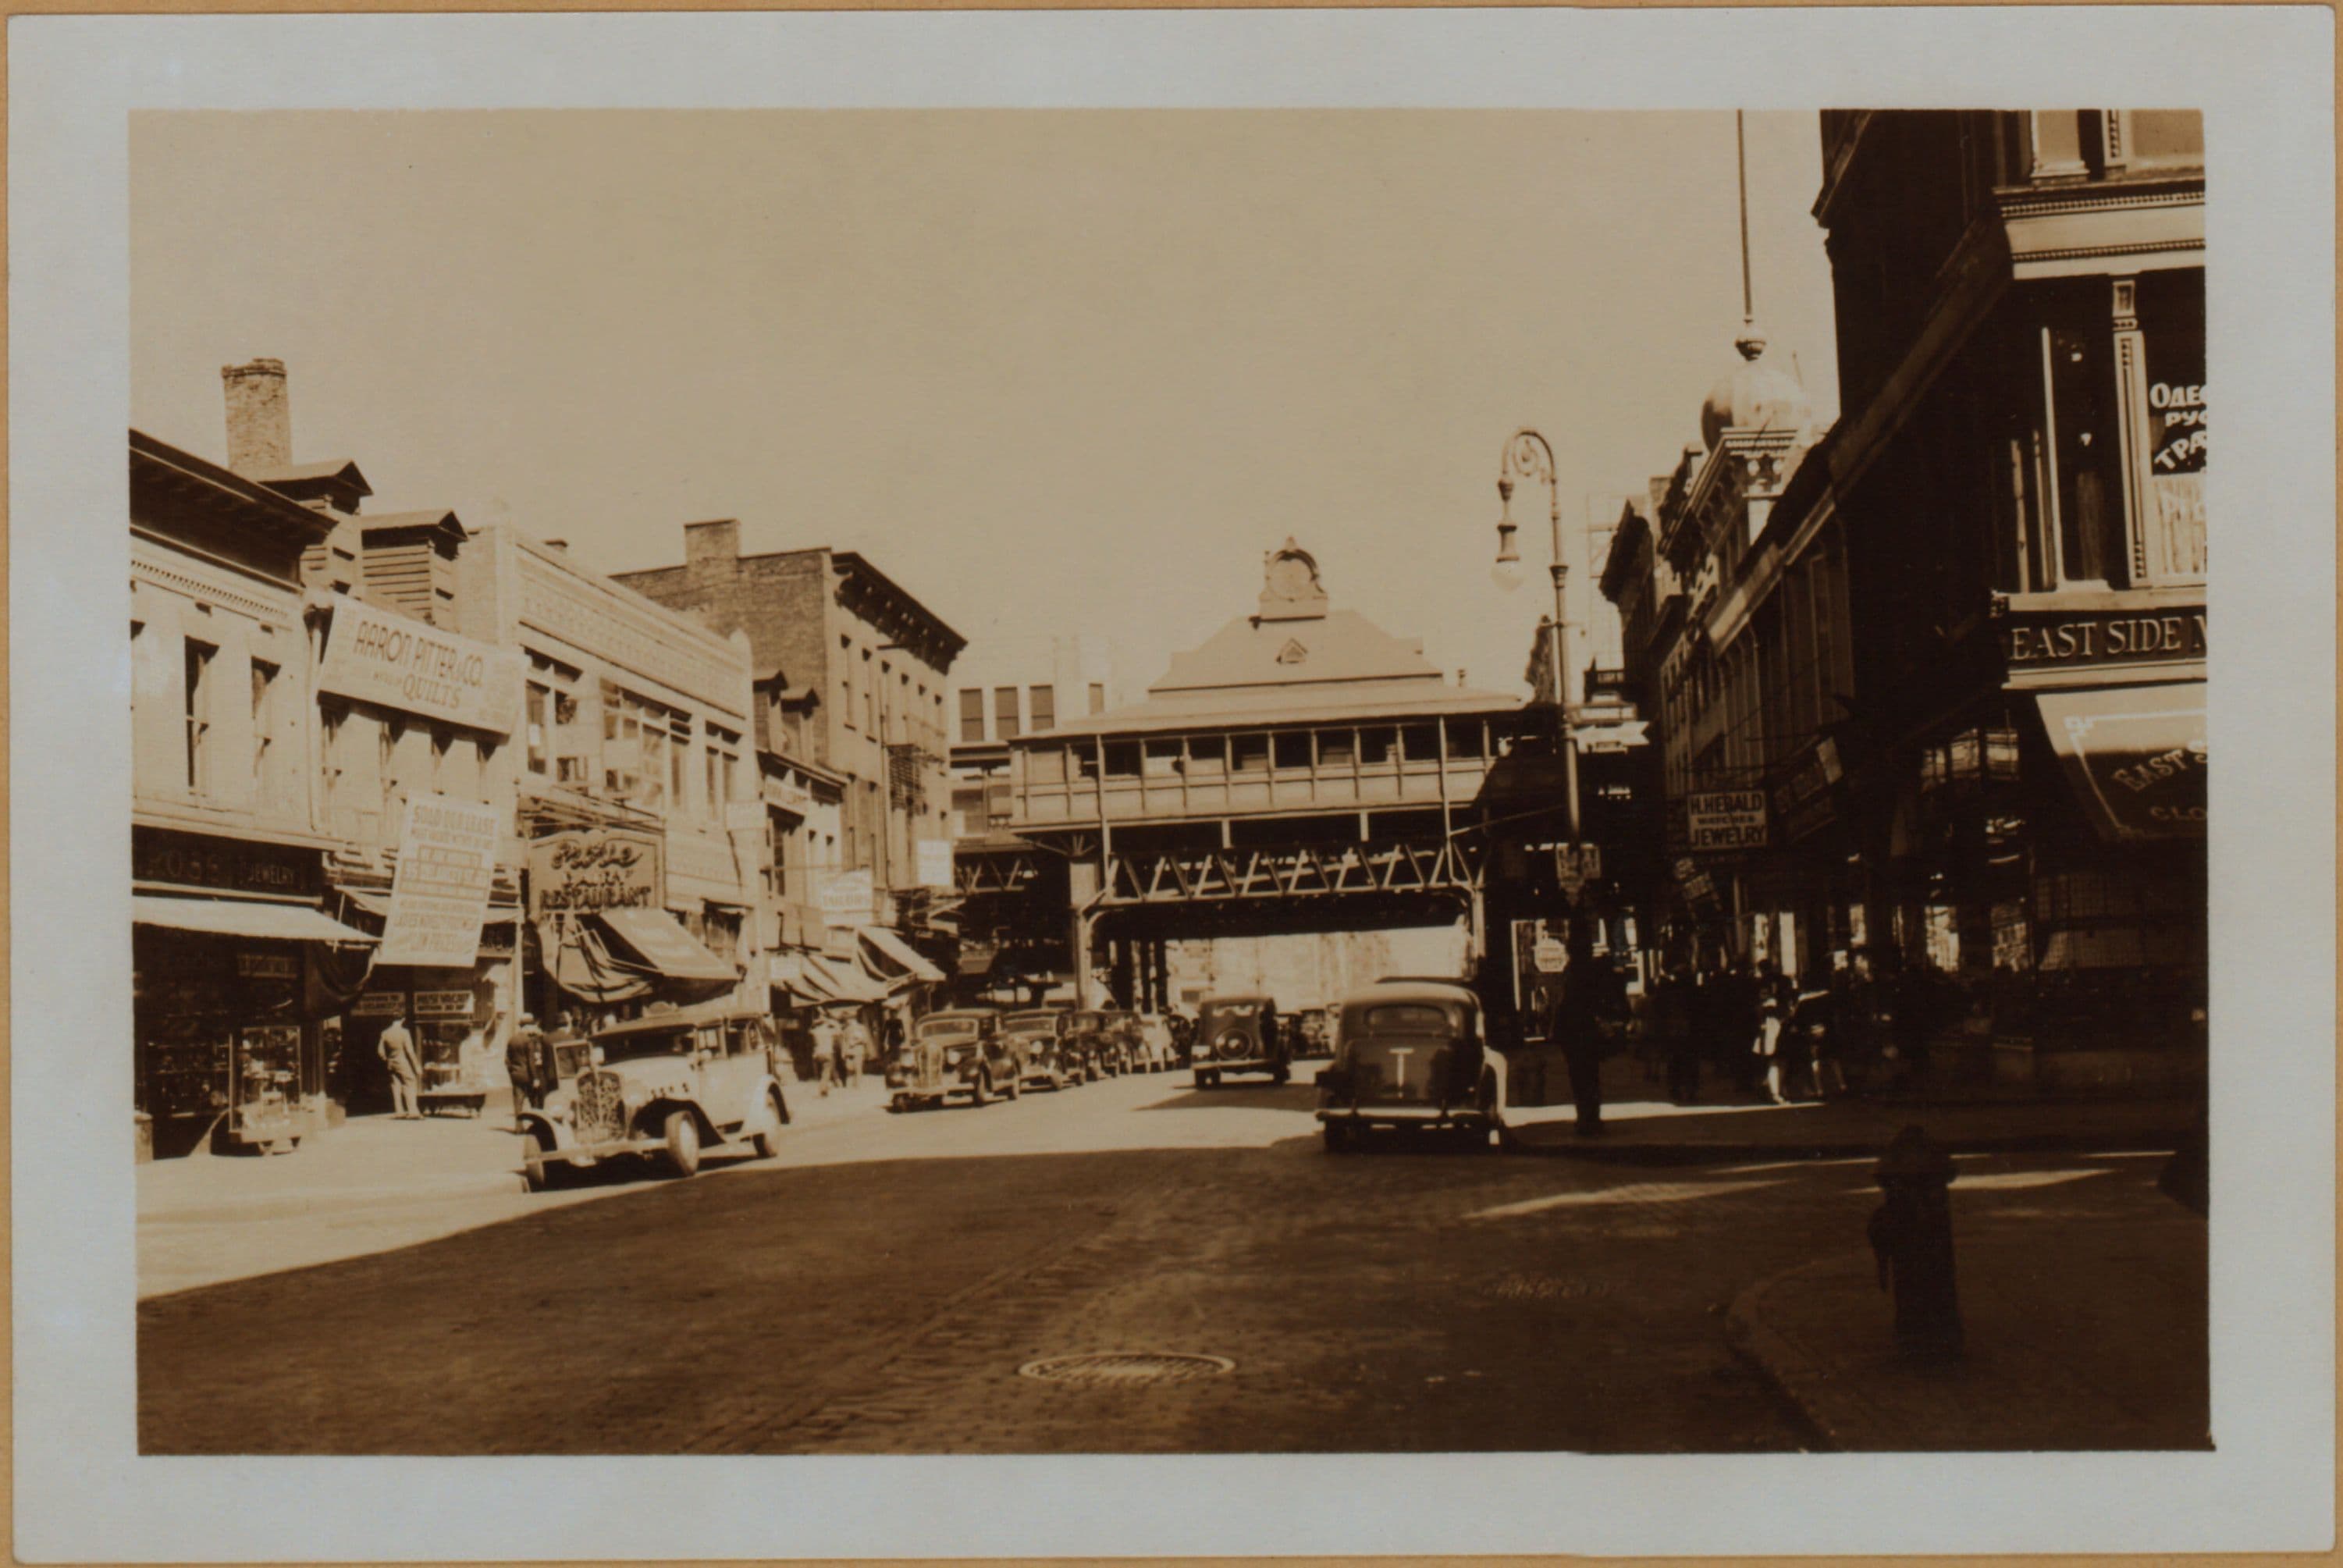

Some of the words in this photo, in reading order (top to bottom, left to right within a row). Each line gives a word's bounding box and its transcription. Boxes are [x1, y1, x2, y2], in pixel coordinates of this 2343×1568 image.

[354, 620, 412, 668] AARON
[2010, 621, 2096, 660] EAST
[2107, 617, 2182, 654] SIDE
[402, 673, 463, 709] QUILTS
[2113, 749, 2188, 791] EAST
[1691, 824, 1765, 847] JEWELRY
